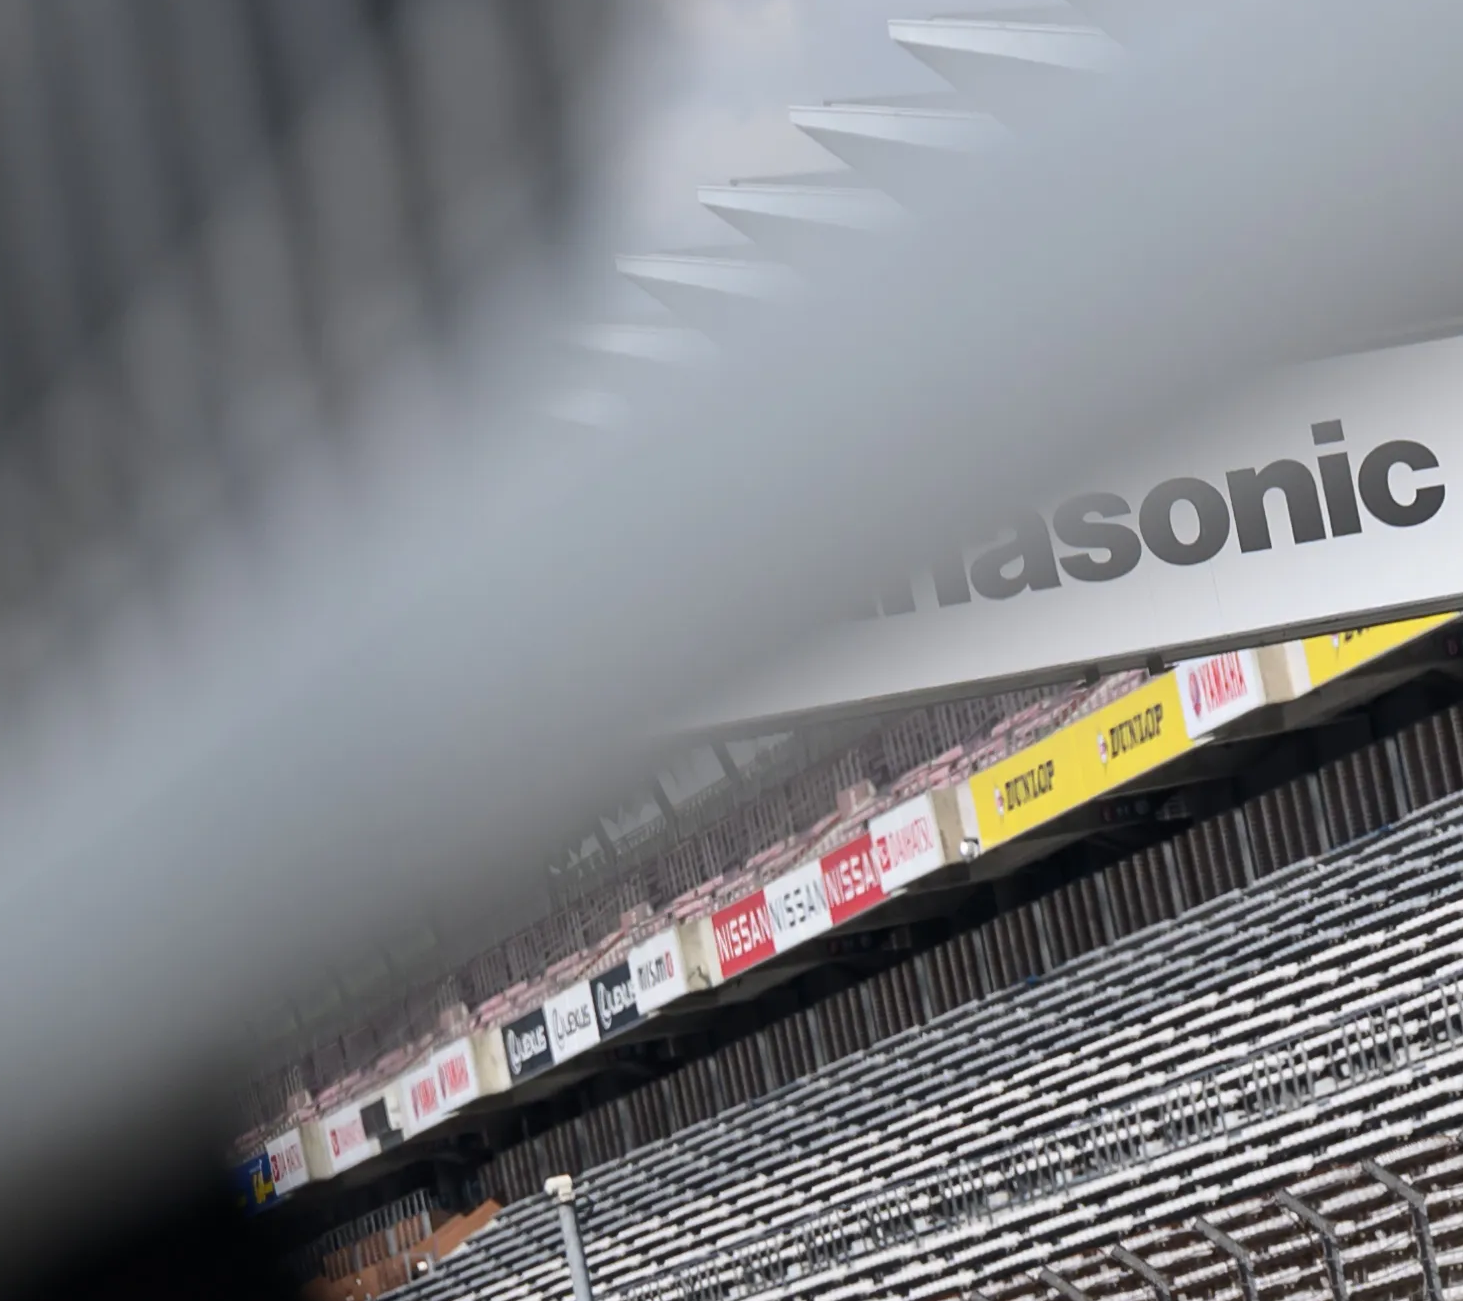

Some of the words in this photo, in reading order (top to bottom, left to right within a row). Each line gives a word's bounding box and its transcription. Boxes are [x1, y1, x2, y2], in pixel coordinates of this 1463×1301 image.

[1109, 702, 1164, 759] DUNLOP
[1004, 759, 1055, 812] DUNLOP
[715, 903, 773, 964] NISSAN
